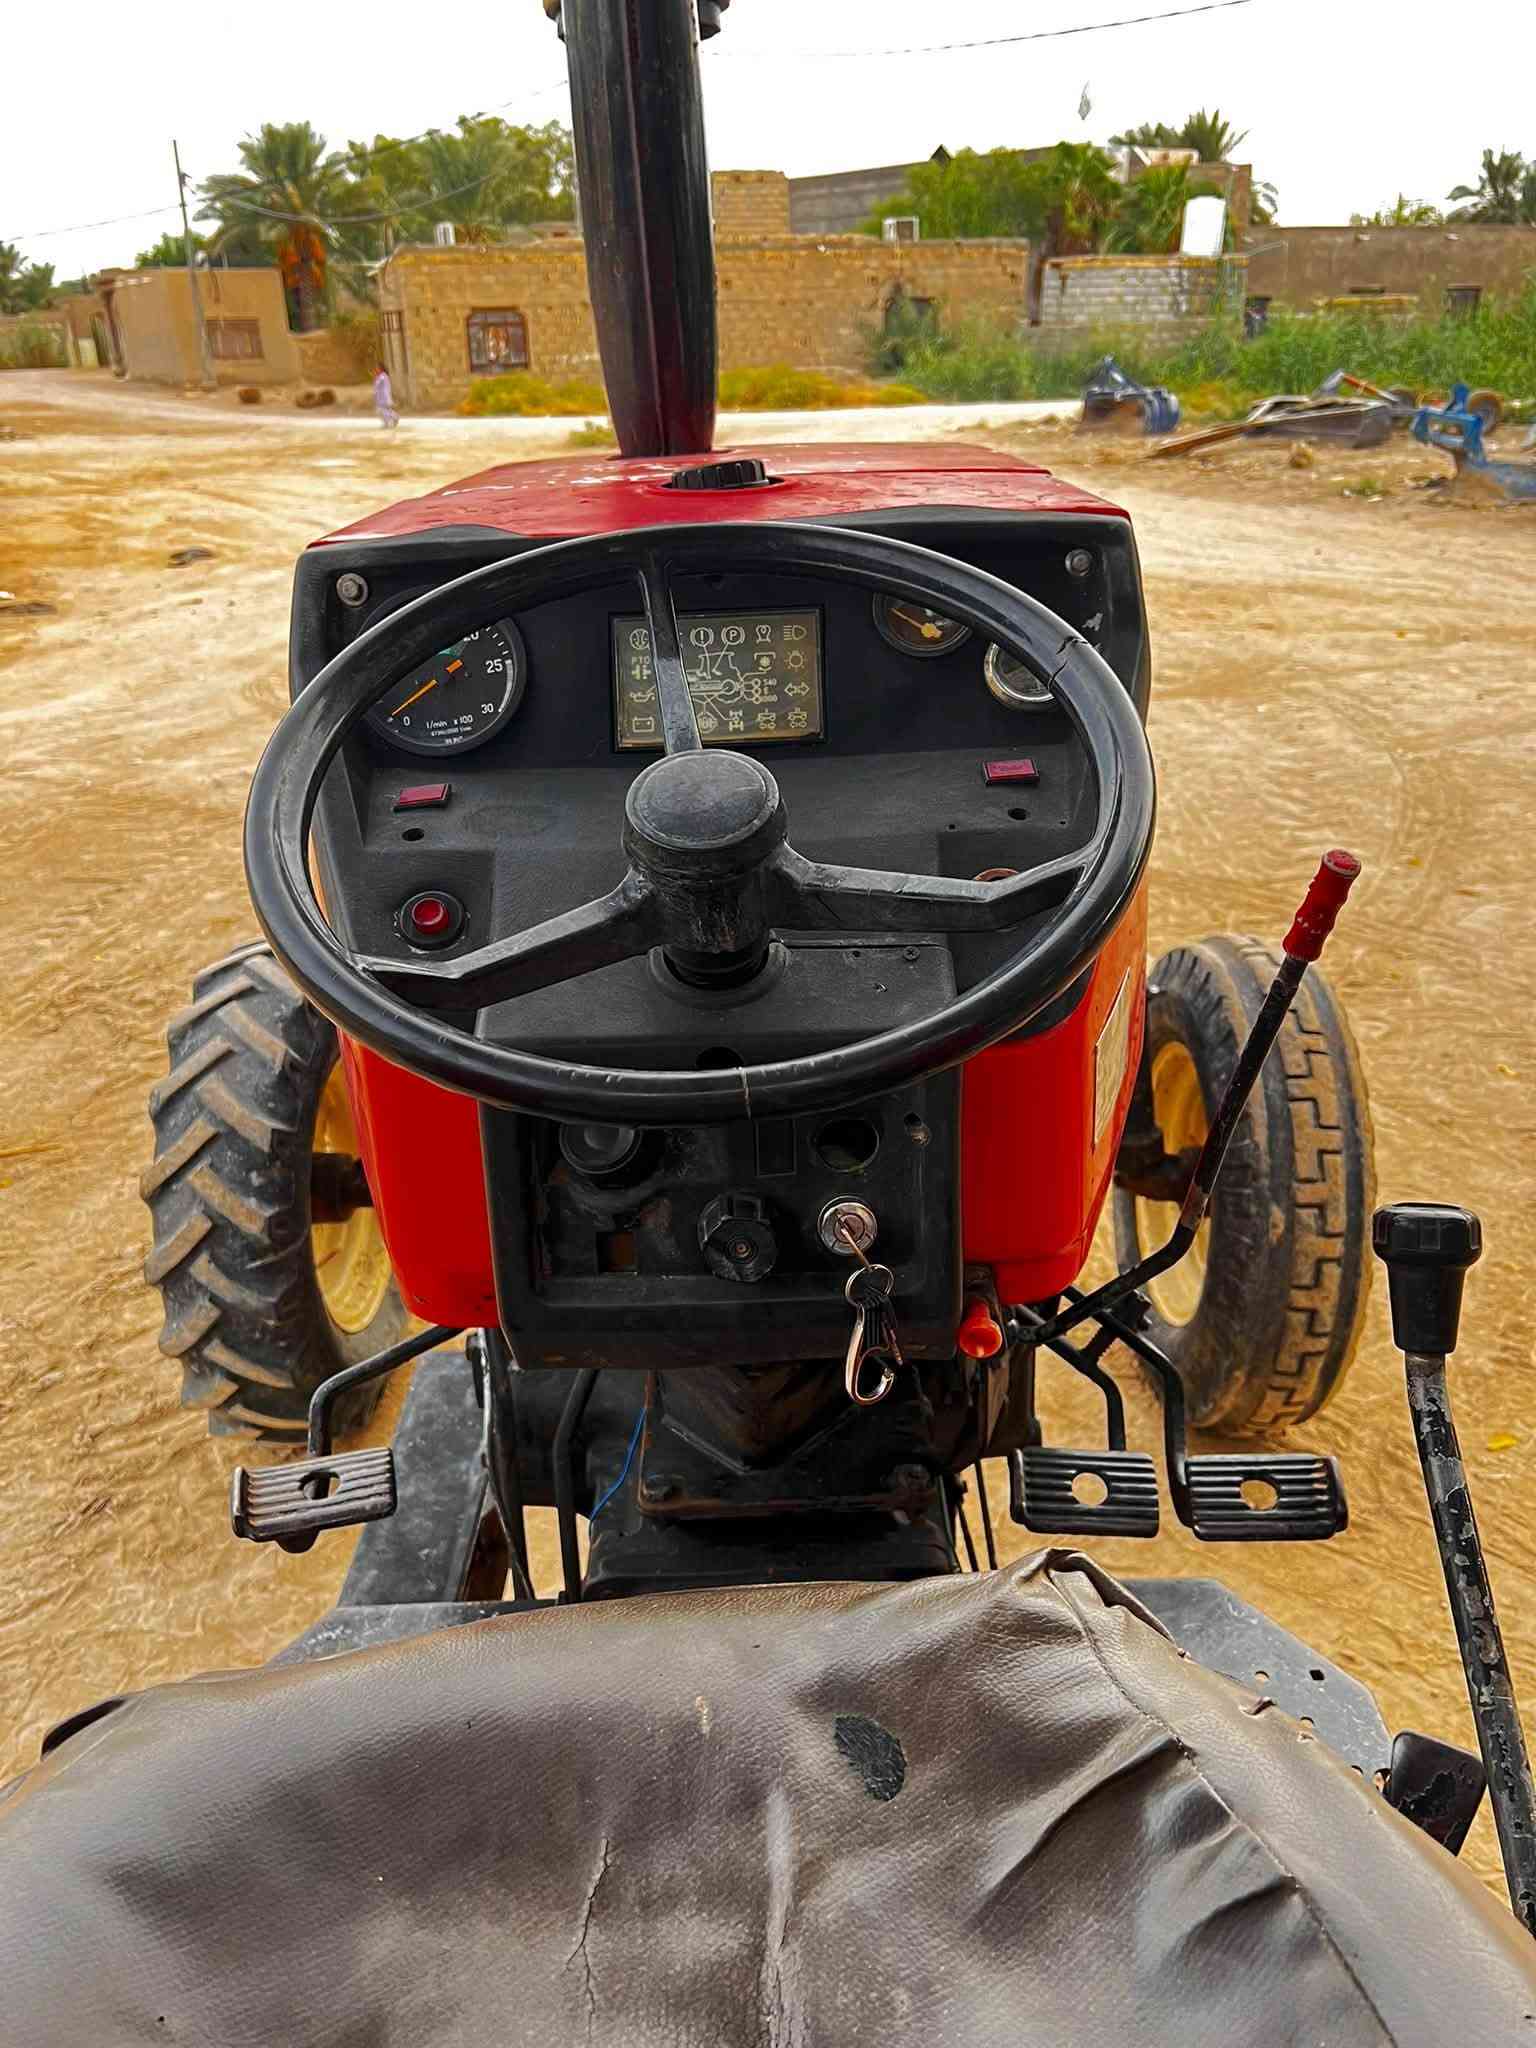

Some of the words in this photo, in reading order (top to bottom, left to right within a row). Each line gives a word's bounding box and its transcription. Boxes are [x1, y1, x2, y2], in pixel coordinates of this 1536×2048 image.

[485, 658, 503, 674] 25
[481, 703, 494, 714] 30
[403, 716, 411, 726] 0
[459, 714, 473, 725] 100
